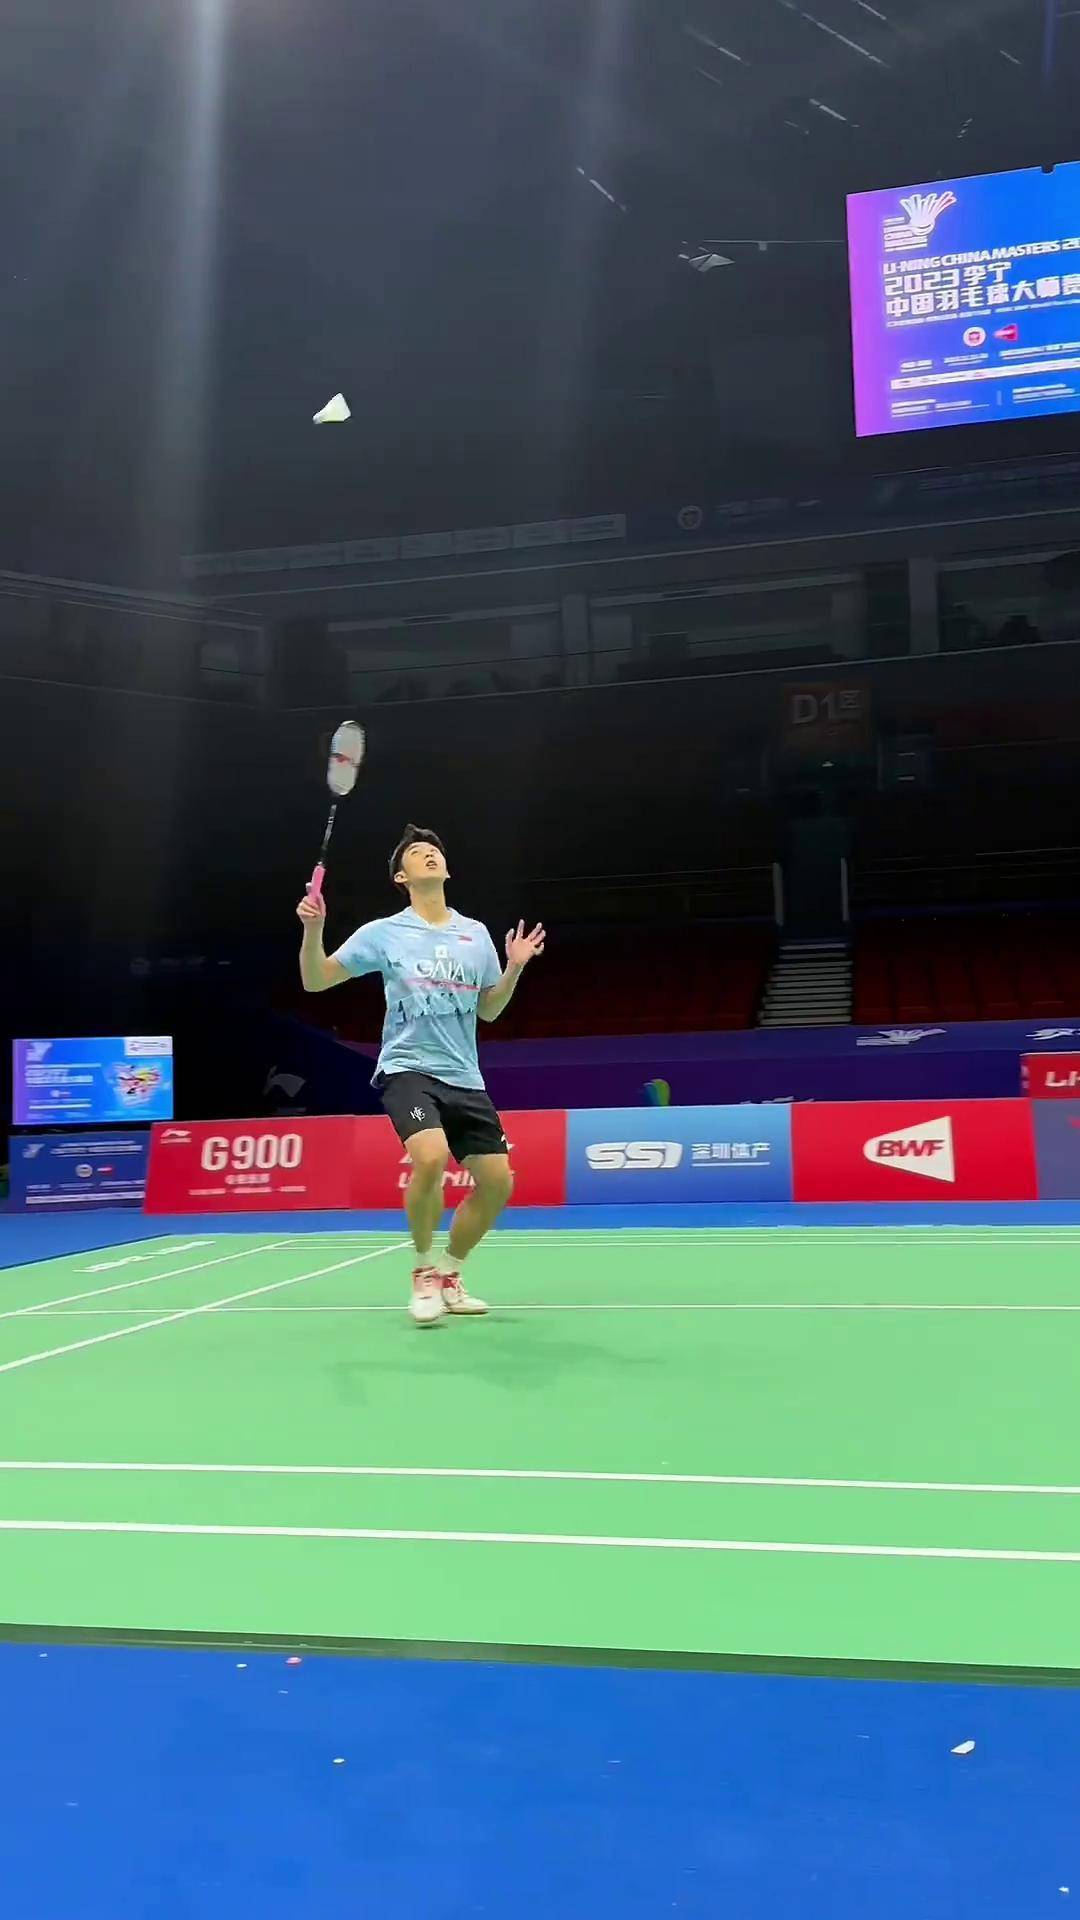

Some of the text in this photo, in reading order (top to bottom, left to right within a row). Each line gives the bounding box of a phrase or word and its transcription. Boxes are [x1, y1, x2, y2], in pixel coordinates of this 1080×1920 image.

[884, 261, 1012, 296] 2023 李宁
[201, 1133, 303, 1171] G900
[876, 1139, 945, 1158] BWF
